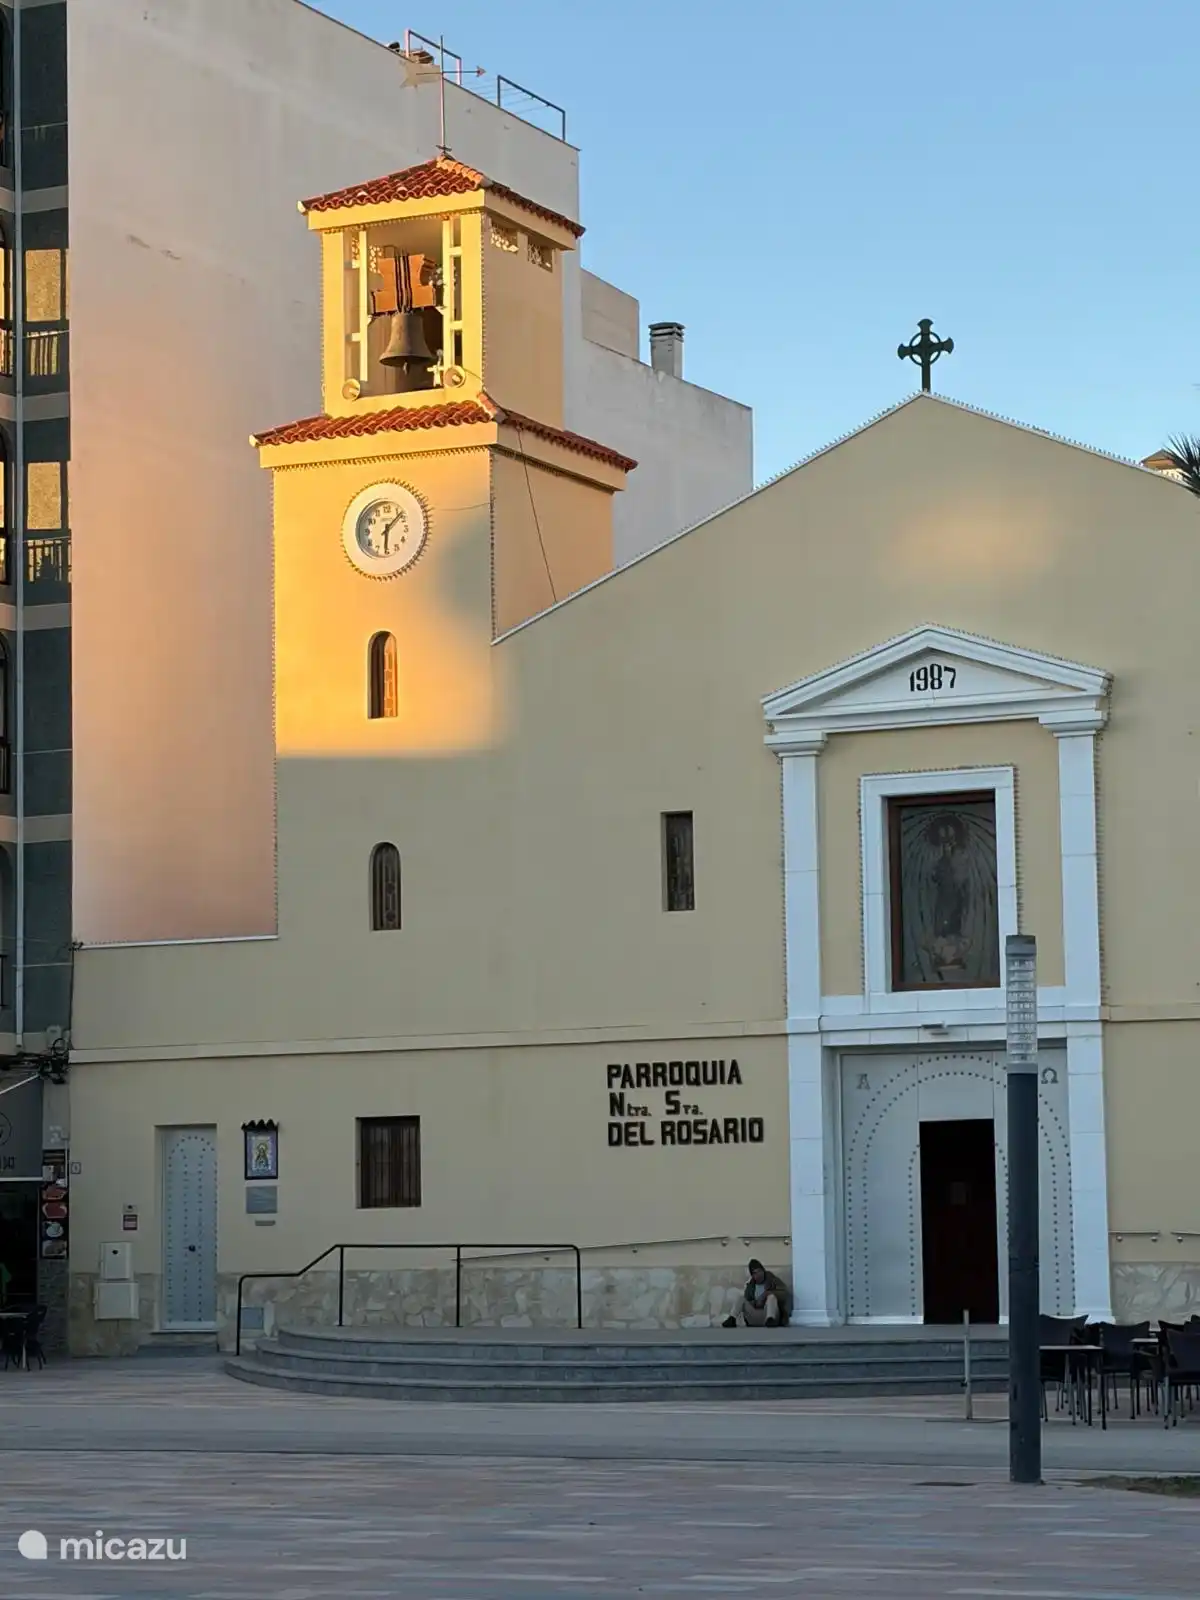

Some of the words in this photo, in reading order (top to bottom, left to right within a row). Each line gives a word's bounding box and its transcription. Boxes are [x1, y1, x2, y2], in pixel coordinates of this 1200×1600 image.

[383, 504, 391, 513] 12
[910, 663, 956, 692] 1987
[607, 1059, 742, 1089] PARROQUIA
[609, 1092, 652, 1117] Ntra.
[665, 1090, 703, 1115] Sra.
[608, 1121, 655, 1147] DEL
[661, 1117, 764, 1146] ROSARIO
